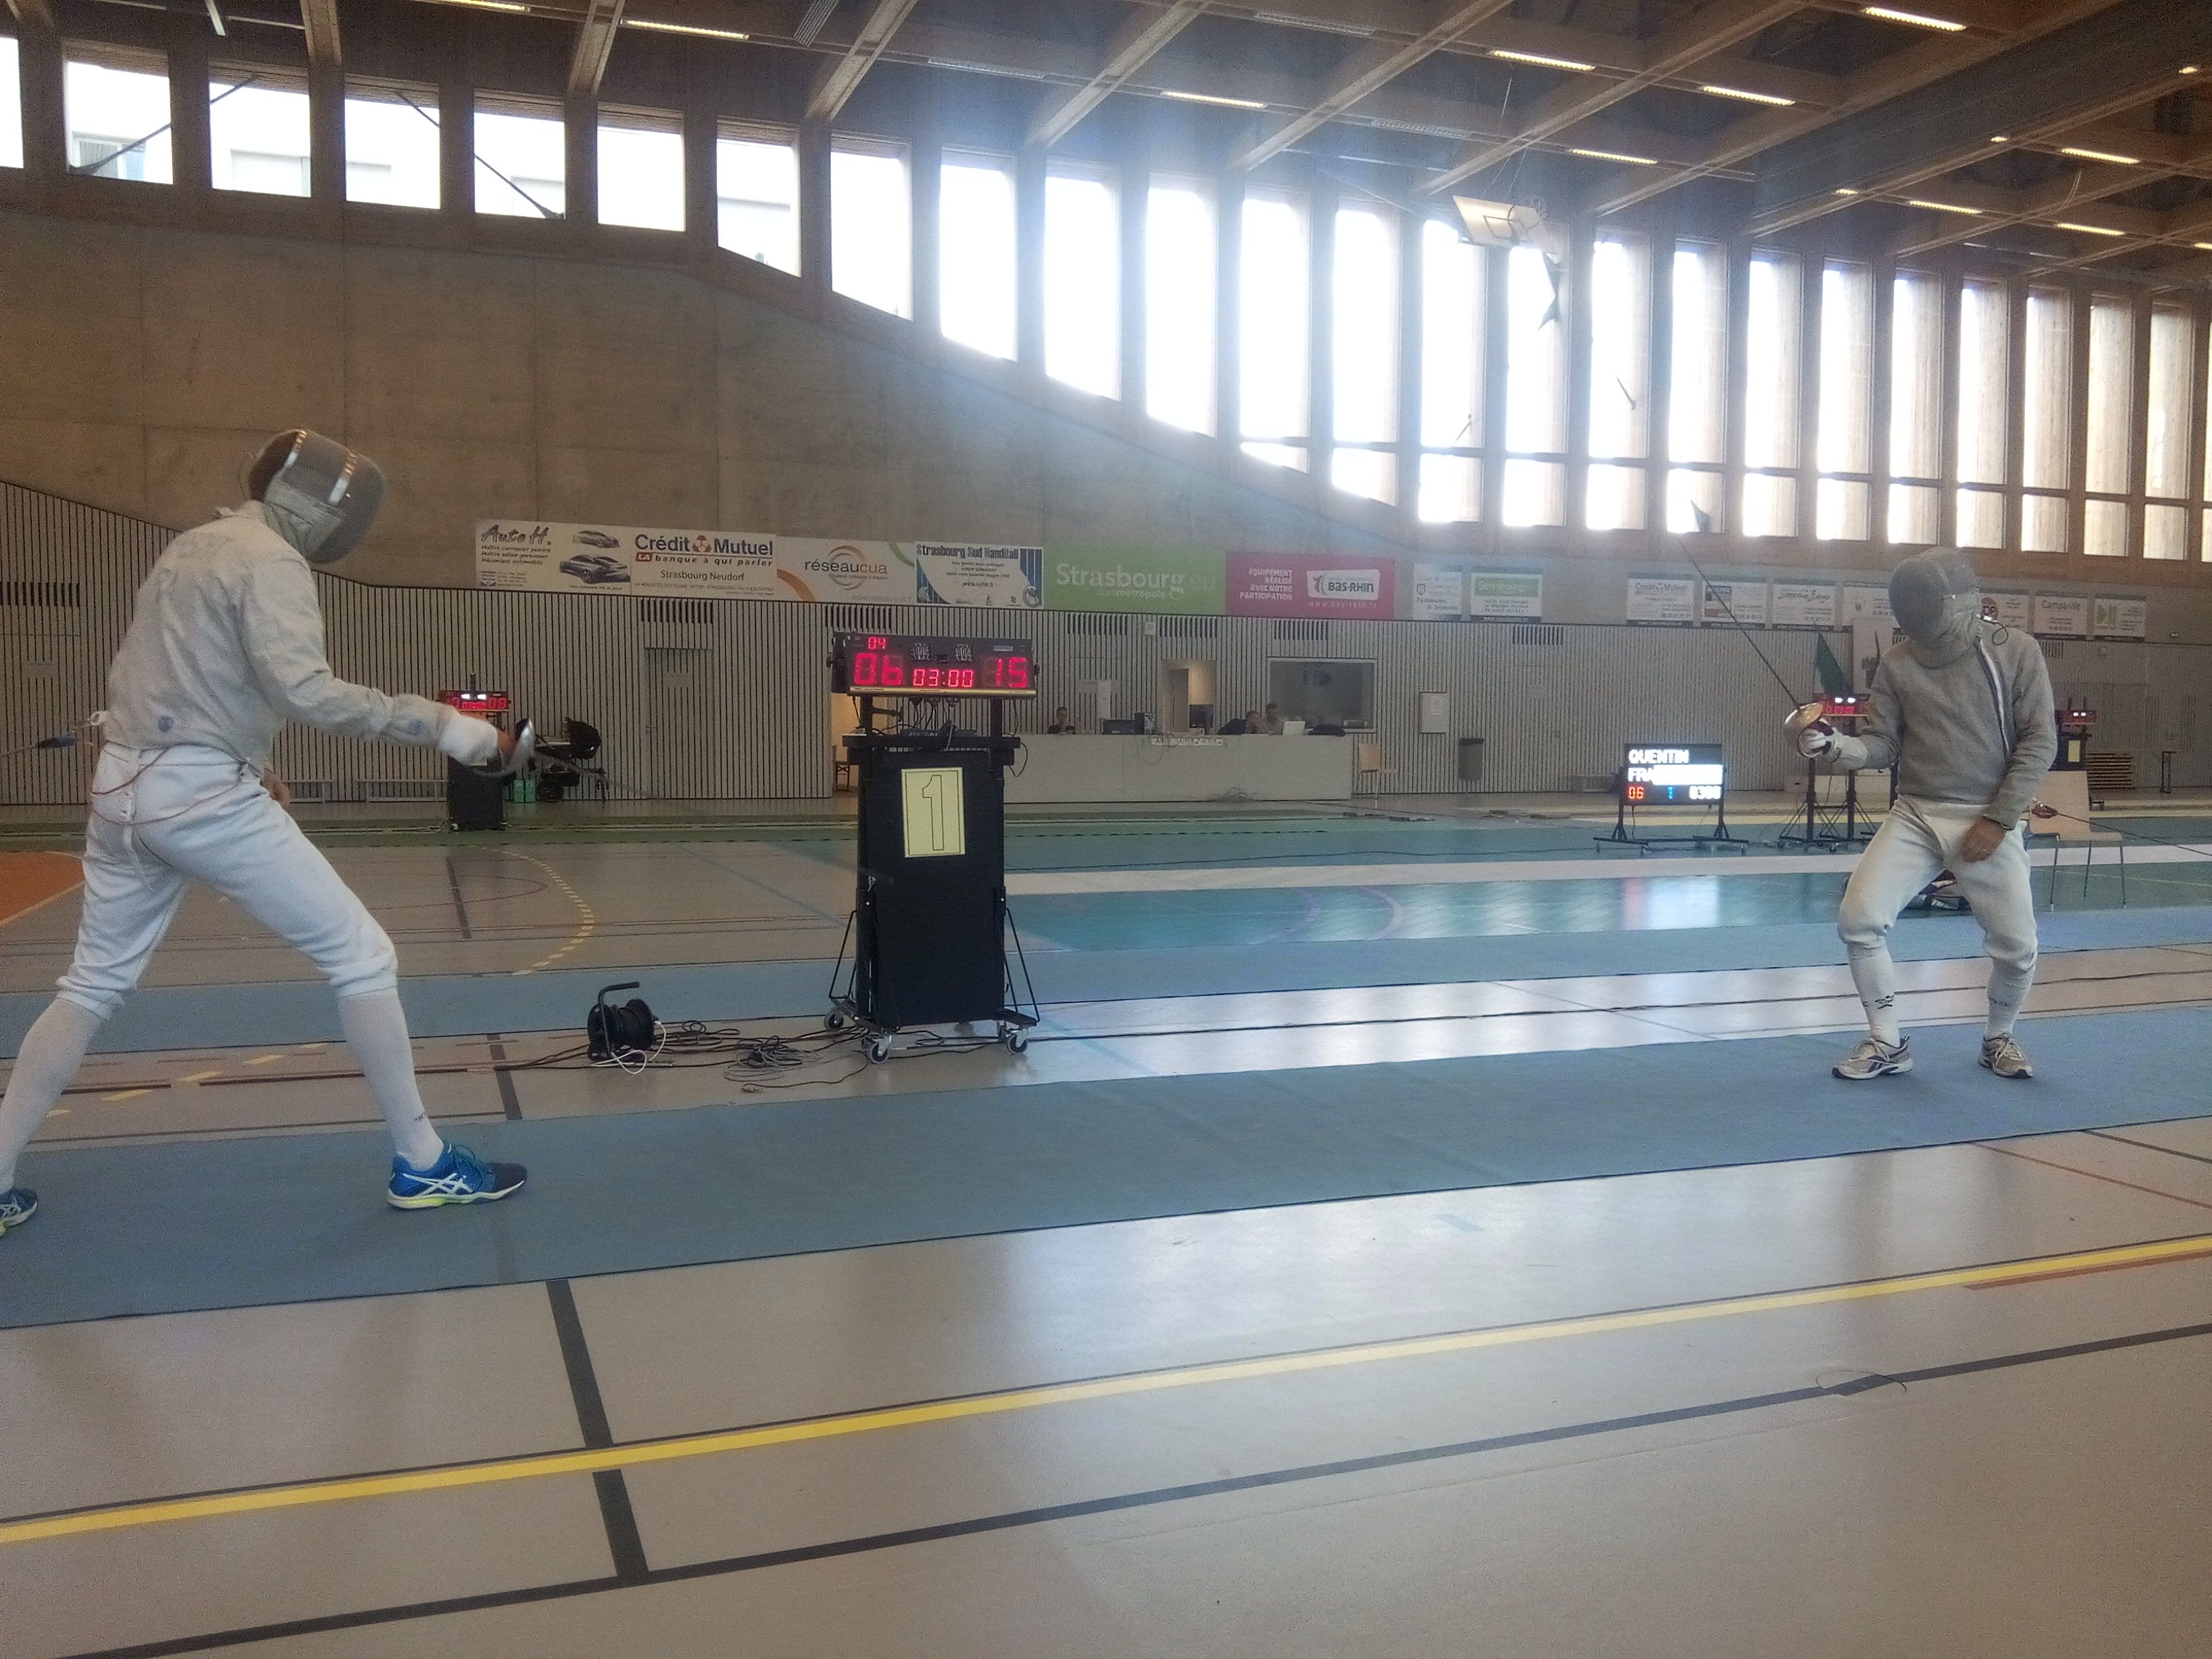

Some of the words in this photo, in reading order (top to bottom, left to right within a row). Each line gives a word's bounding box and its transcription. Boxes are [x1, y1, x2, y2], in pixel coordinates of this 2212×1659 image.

[481, 525, 526, 542] Auto
[634, 534, 690, 552] Crédit
[714, 538, 773, 556] Mutuel
[916, 544, 966, 558] Strasbourg
[968, 547, 983, 558] Sud
[655, 554, 697, 563] banque
[714, 558, 732, 566] qui
[737, 558, 773, 567] parler
[805, 558, 888, 574] réseaucua
[661, 570, 708, 581] Strasbourg
[710, 572, 745, 581] Neudorf
[1240, 592, 1292, 600] PARTICIPATION
[867, 636, 886, 650] 04
[854, 653, 903, 686] 06
[913, 668, 975, 688] 03:00
[996, 657, 1027, 688] 15
[1629, 749, 1689, 764] QUENTIN
[1628, 786, 1644, 799] 06
[922, 775, 945, 851] 1
